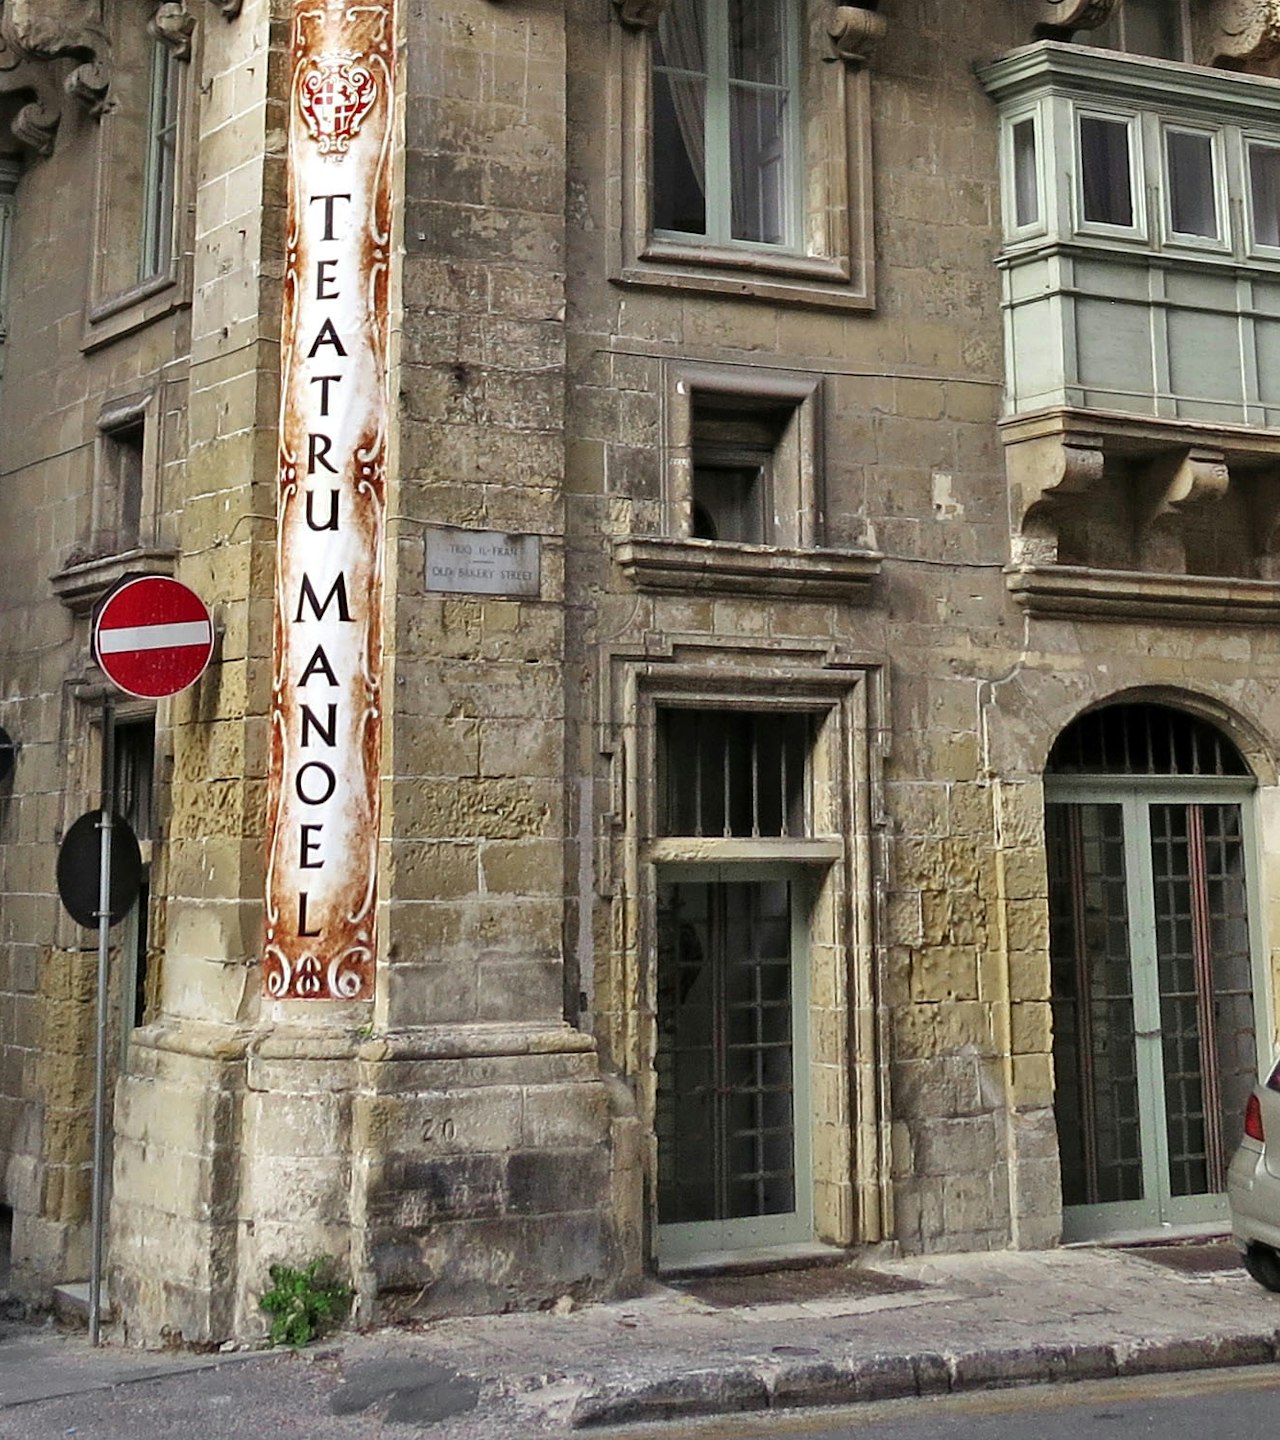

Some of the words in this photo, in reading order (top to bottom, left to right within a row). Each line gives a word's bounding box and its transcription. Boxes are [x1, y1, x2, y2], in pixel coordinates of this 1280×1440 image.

[305, 193, 351, 532] TEATRU
[432, 566, 453, 577] OLD
[459, 567, 495, 579] BAKERY
[501, 569, 533, 581] STREET
[292, 571, 357, 938] MANOEL
